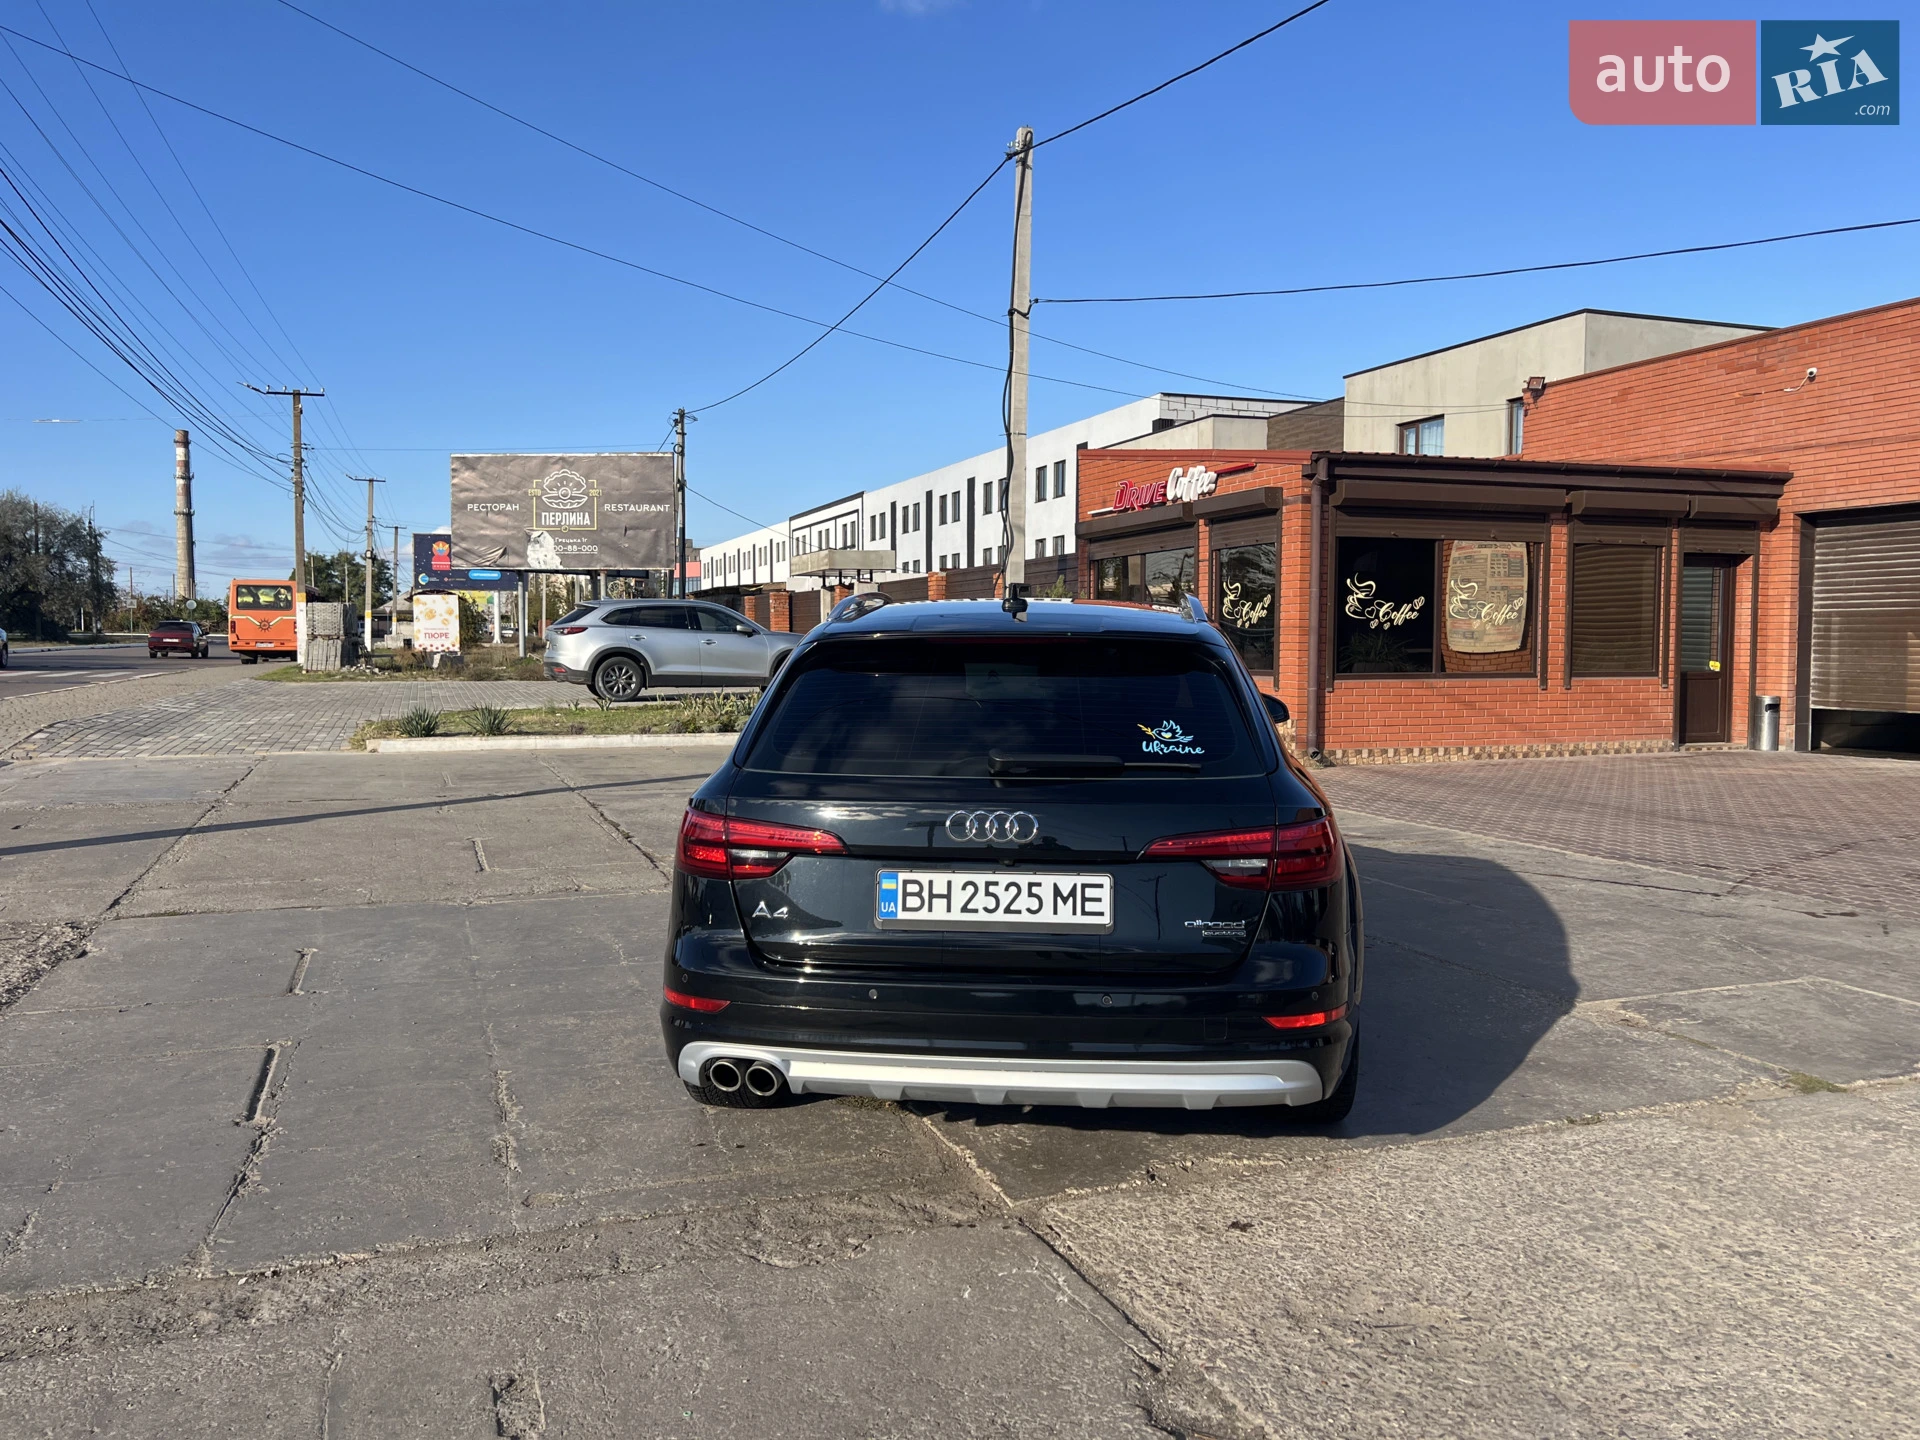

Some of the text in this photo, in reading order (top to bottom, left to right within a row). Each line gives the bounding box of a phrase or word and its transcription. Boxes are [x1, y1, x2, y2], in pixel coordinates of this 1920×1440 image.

[1166, 465, 1217, 502] Coffee
[589, 489, 602, 497] 2021
[467, 503, 520, 512] РЕСТОРАН
[604, 504, 671, 513] RESTAURANT
[541, 512, 591, 526] ПЕРЛИНА
[1240, 600, 1268, 624] Coffee
[1374, 600, 1420, 627] Coffee
[1476, 600, 1519, 626] Coffee
[1142, 741, 1205, 755] Ukraine
[901, 879, 1105, 917] BH 2525 ME
[752, 900, 789, 919] A4
[881, 901, 896, 913] UA
[1184, 919, 1246, 929] allroad
